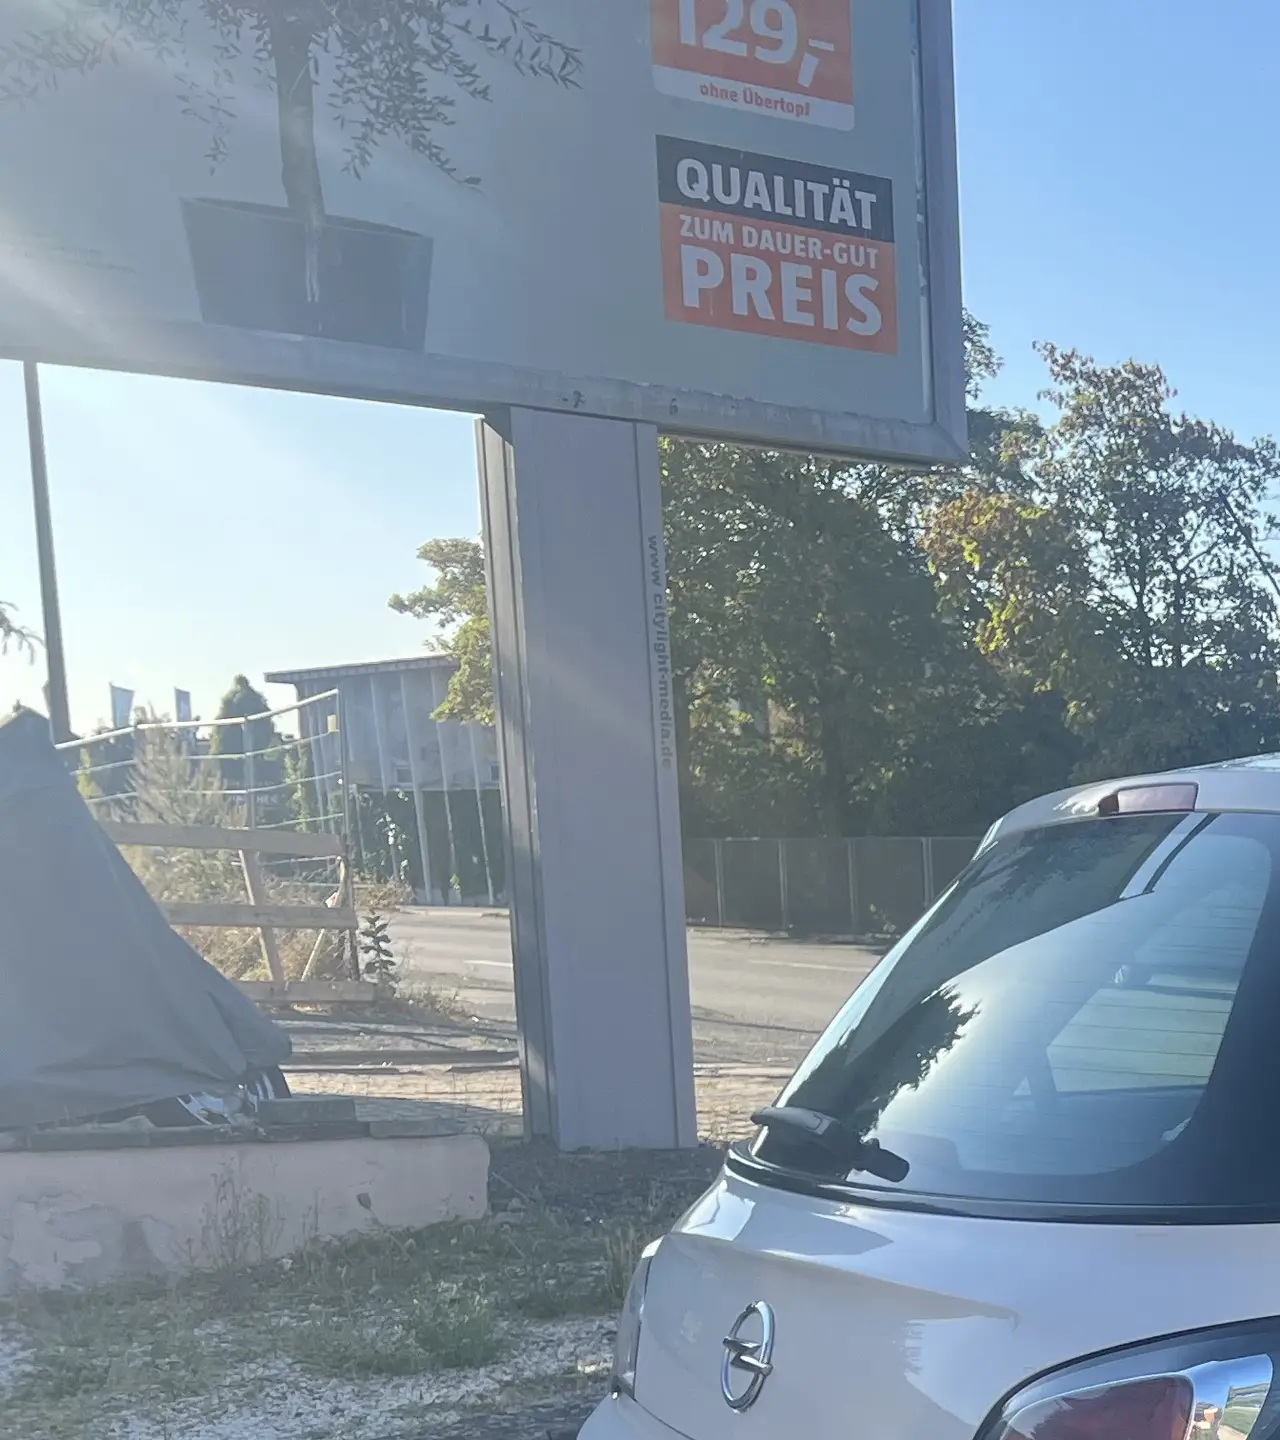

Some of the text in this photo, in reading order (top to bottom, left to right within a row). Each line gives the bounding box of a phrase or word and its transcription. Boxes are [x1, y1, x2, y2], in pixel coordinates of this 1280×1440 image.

[700, 82, 739, 103] ohne
[676, 157, 877, 230] QUALITÄT
[679, 214, 879, 270] ZUM DAUER-GUT
[680, 243, 883, 336] PREIS
